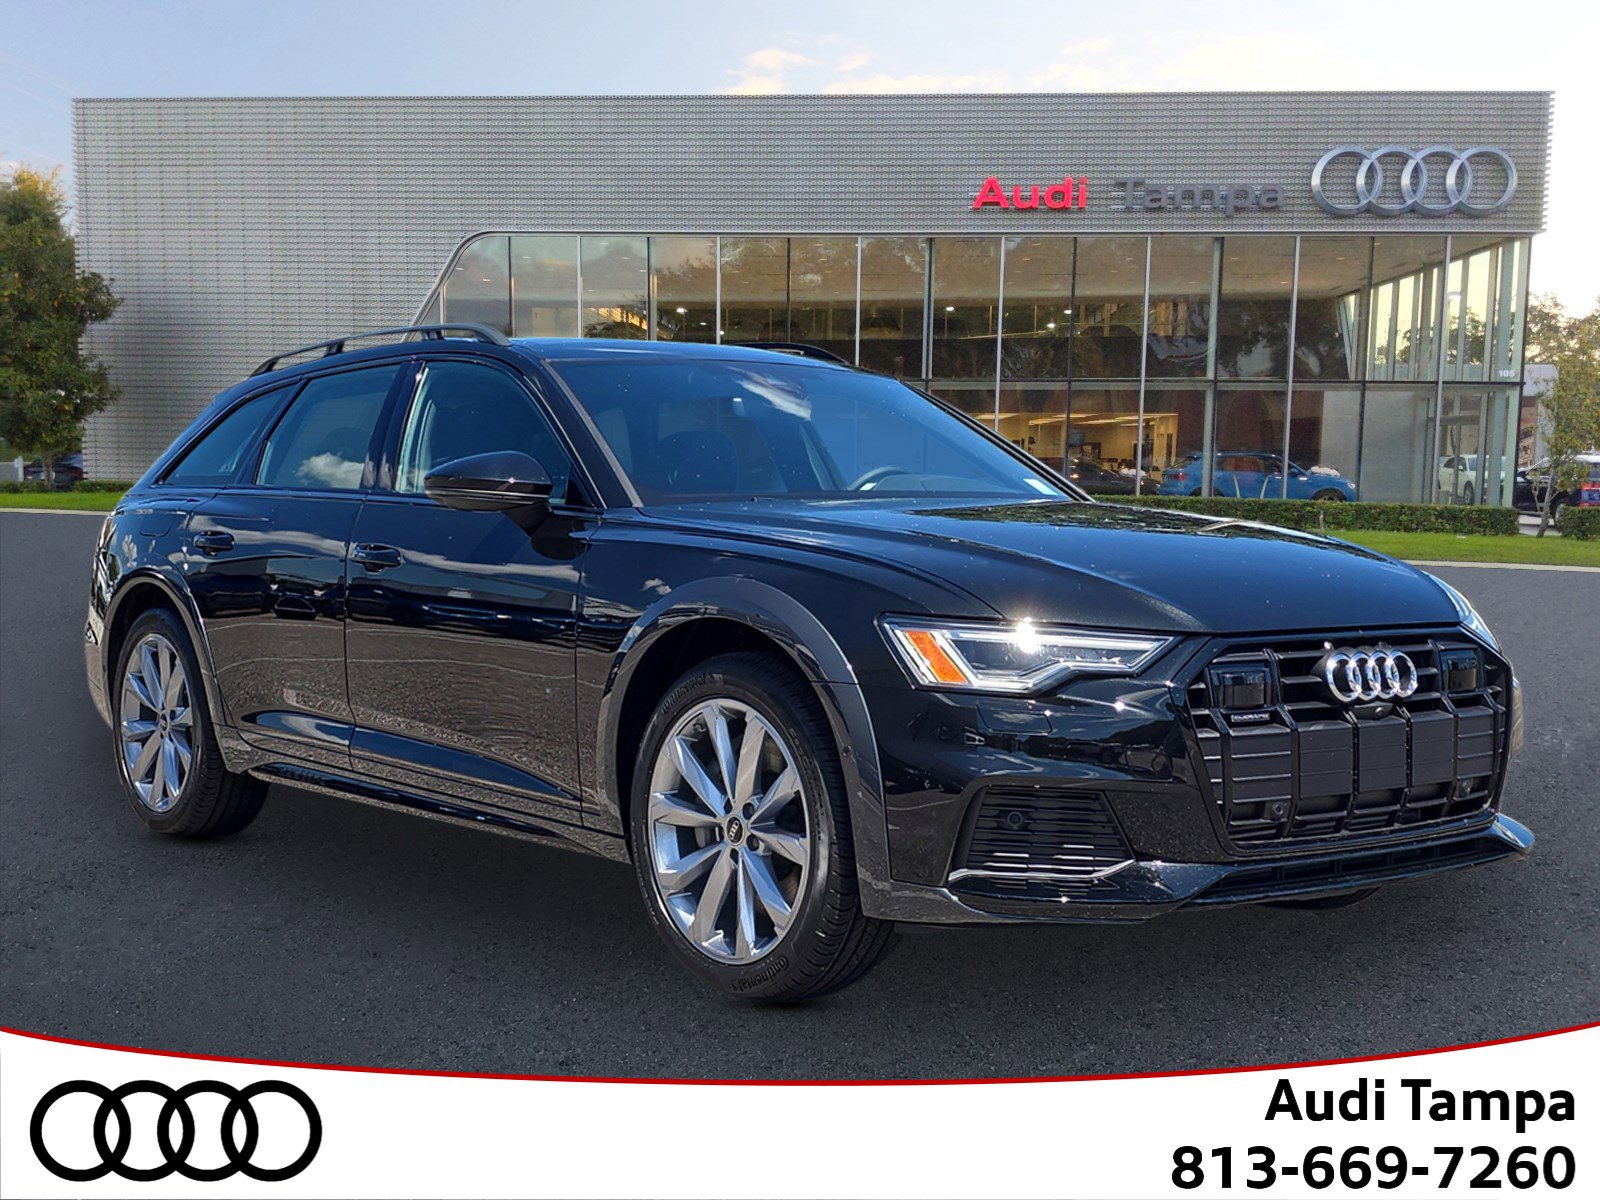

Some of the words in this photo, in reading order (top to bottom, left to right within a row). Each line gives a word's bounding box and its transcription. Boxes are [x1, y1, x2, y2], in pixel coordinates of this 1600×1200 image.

[972, 176, 1088, 210] Audi
[1114, 178, 1284, 217] Tampa
[1498, 369, 1516, 378] 105
